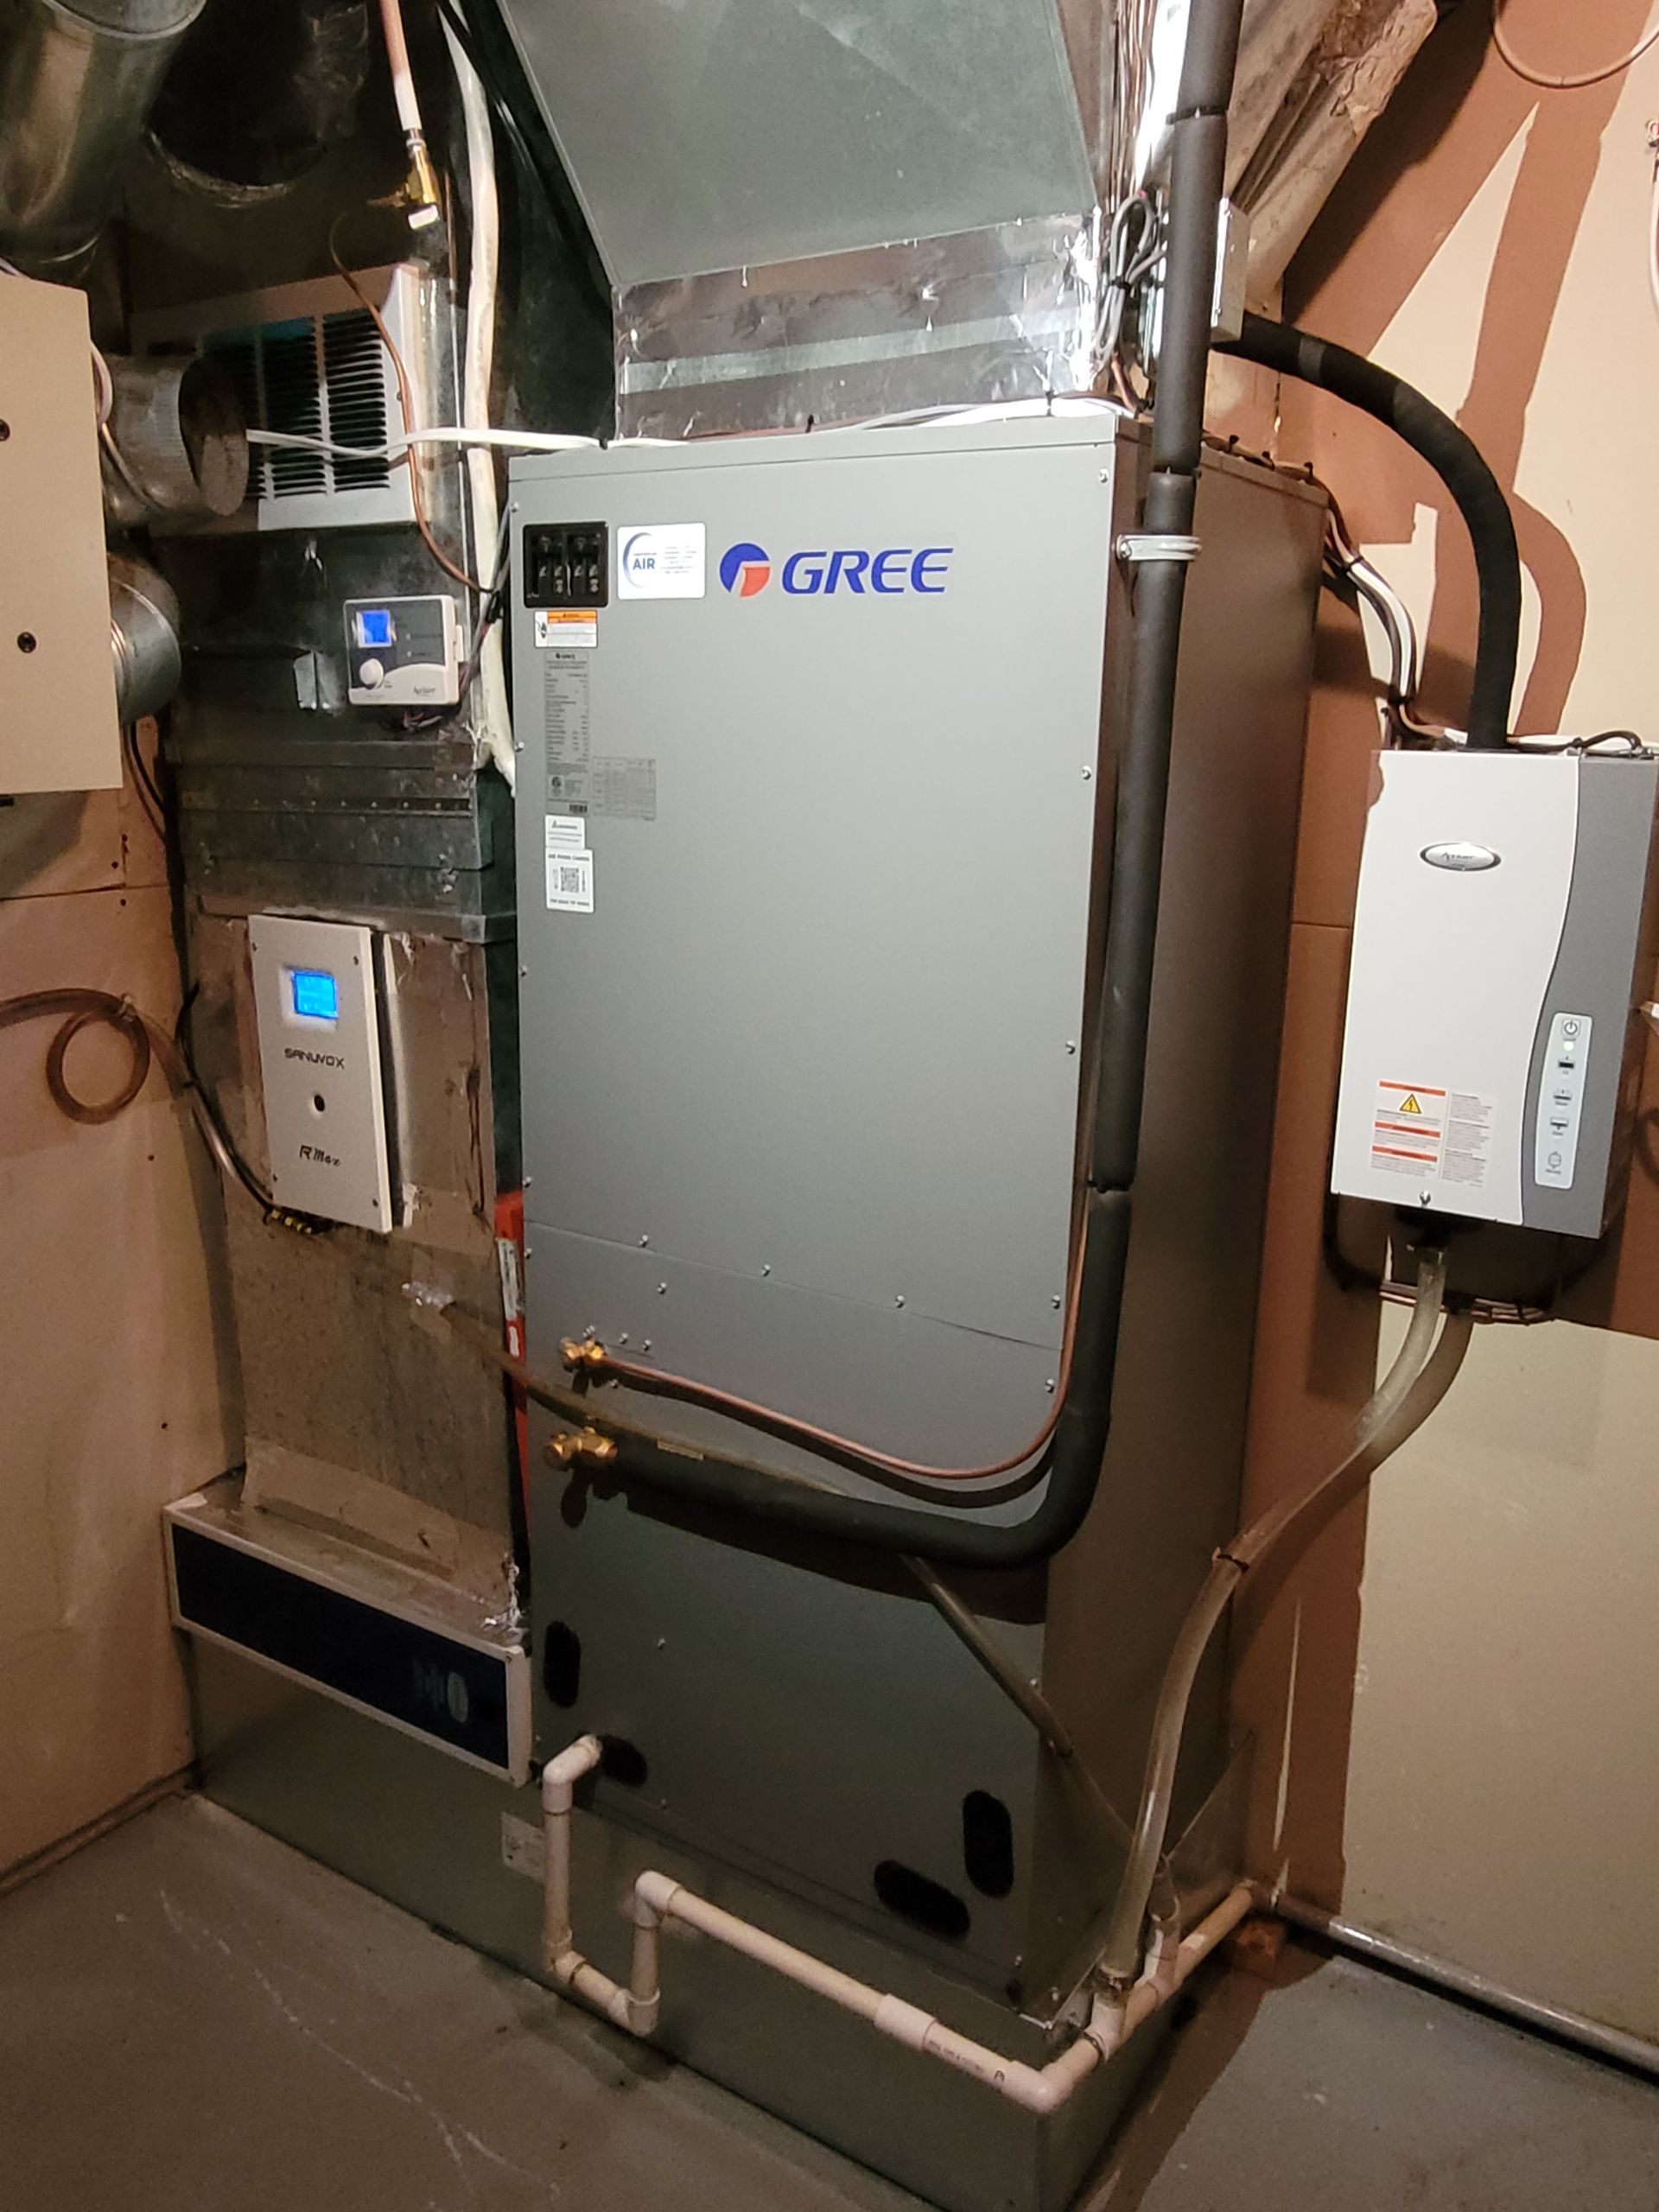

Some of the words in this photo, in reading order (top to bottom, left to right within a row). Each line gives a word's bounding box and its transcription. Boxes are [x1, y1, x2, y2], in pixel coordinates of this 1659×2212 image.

[632, 558, 655, 570] AIR
[782, 548, 954, 594] GREE
[284, 1048, 345, 1069] SANUVOX
